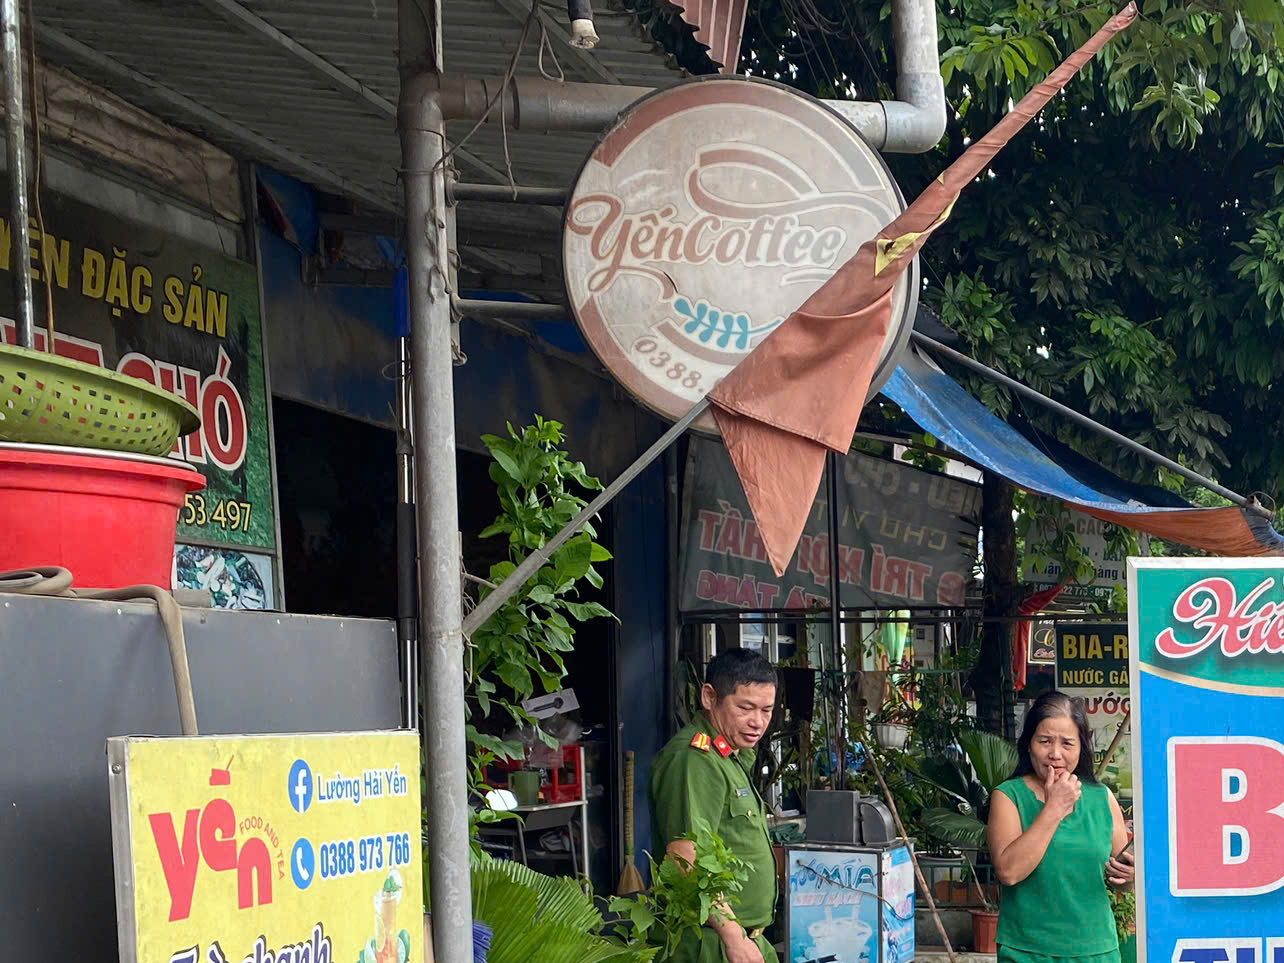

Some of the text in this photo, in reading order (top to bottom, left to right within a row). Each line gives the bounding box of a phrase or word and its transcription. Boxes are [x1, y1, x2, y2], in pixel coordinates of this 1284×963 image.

[82, 246, 152, 317] ĐẶC
[163, 266, 228, 338] SẢN
[211, 500, 251, 532] 497
[1063, 670, 1105, 685] NƯỚC
[317, 765, 407, 804] Lường Hải Yến
[239, 816, 286, 881] FOOD AND TEA
[320, 833, 410, 879] 0388 973 766
